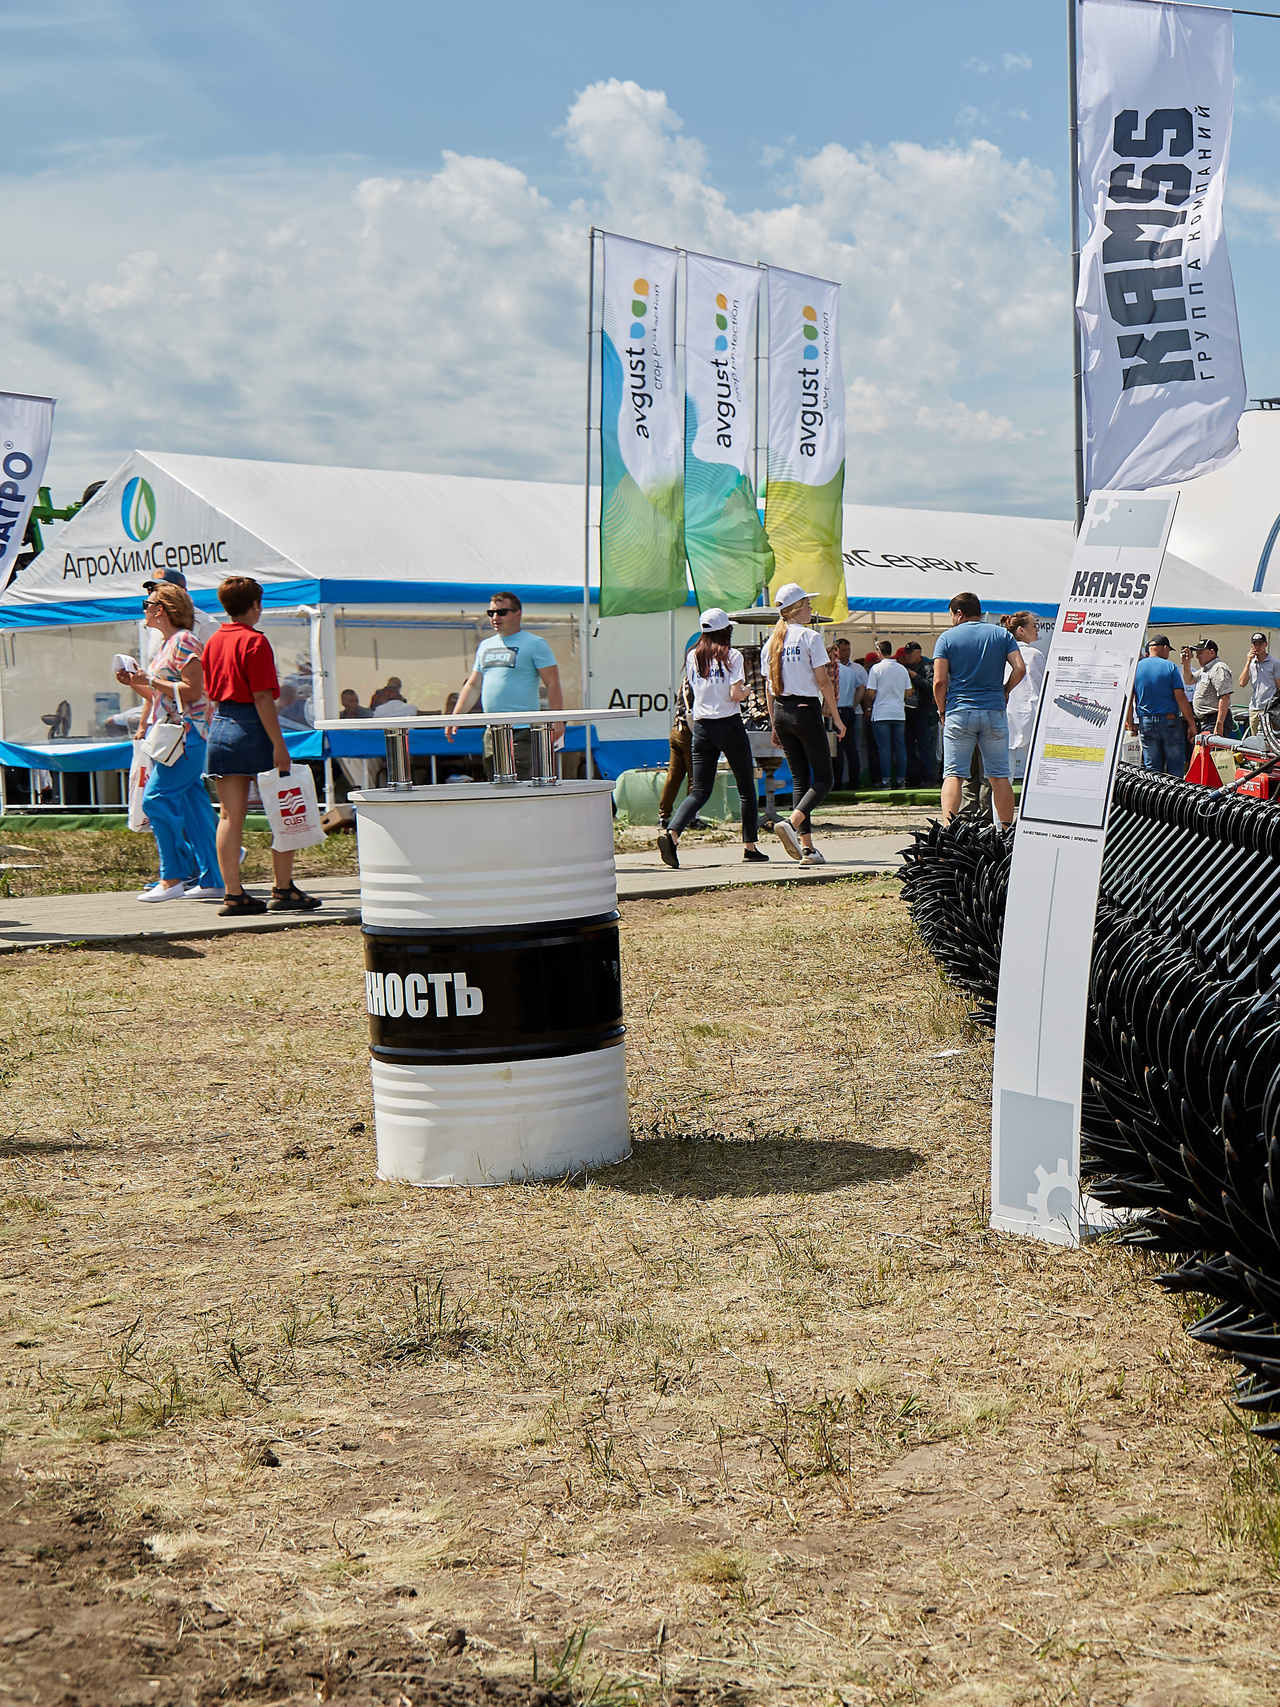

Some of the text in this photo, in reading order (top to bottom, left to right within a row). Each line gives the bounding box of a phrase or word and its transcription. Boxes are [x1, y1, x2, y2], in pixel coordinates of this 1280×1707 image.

[1101, 106, 1194, 391] KAMSS
[1187, 105, 1215, 380] ГРУППА КОМПАНИЙ
[625, 346, 653, 439] avgust
[654, 359, 663, 391] crop
[711, 358, 736, 448] avgust
[798, 367, 824, 457] avgust
[62, 541, 229, 584] АгроХимСервис
[1070, 570, 1151, 599] KAMSS
[1084, 627, 1113, 636] СЕРВИСА
[1086, 620, 1140, 629] КАЧЕСТВЕННОГО
